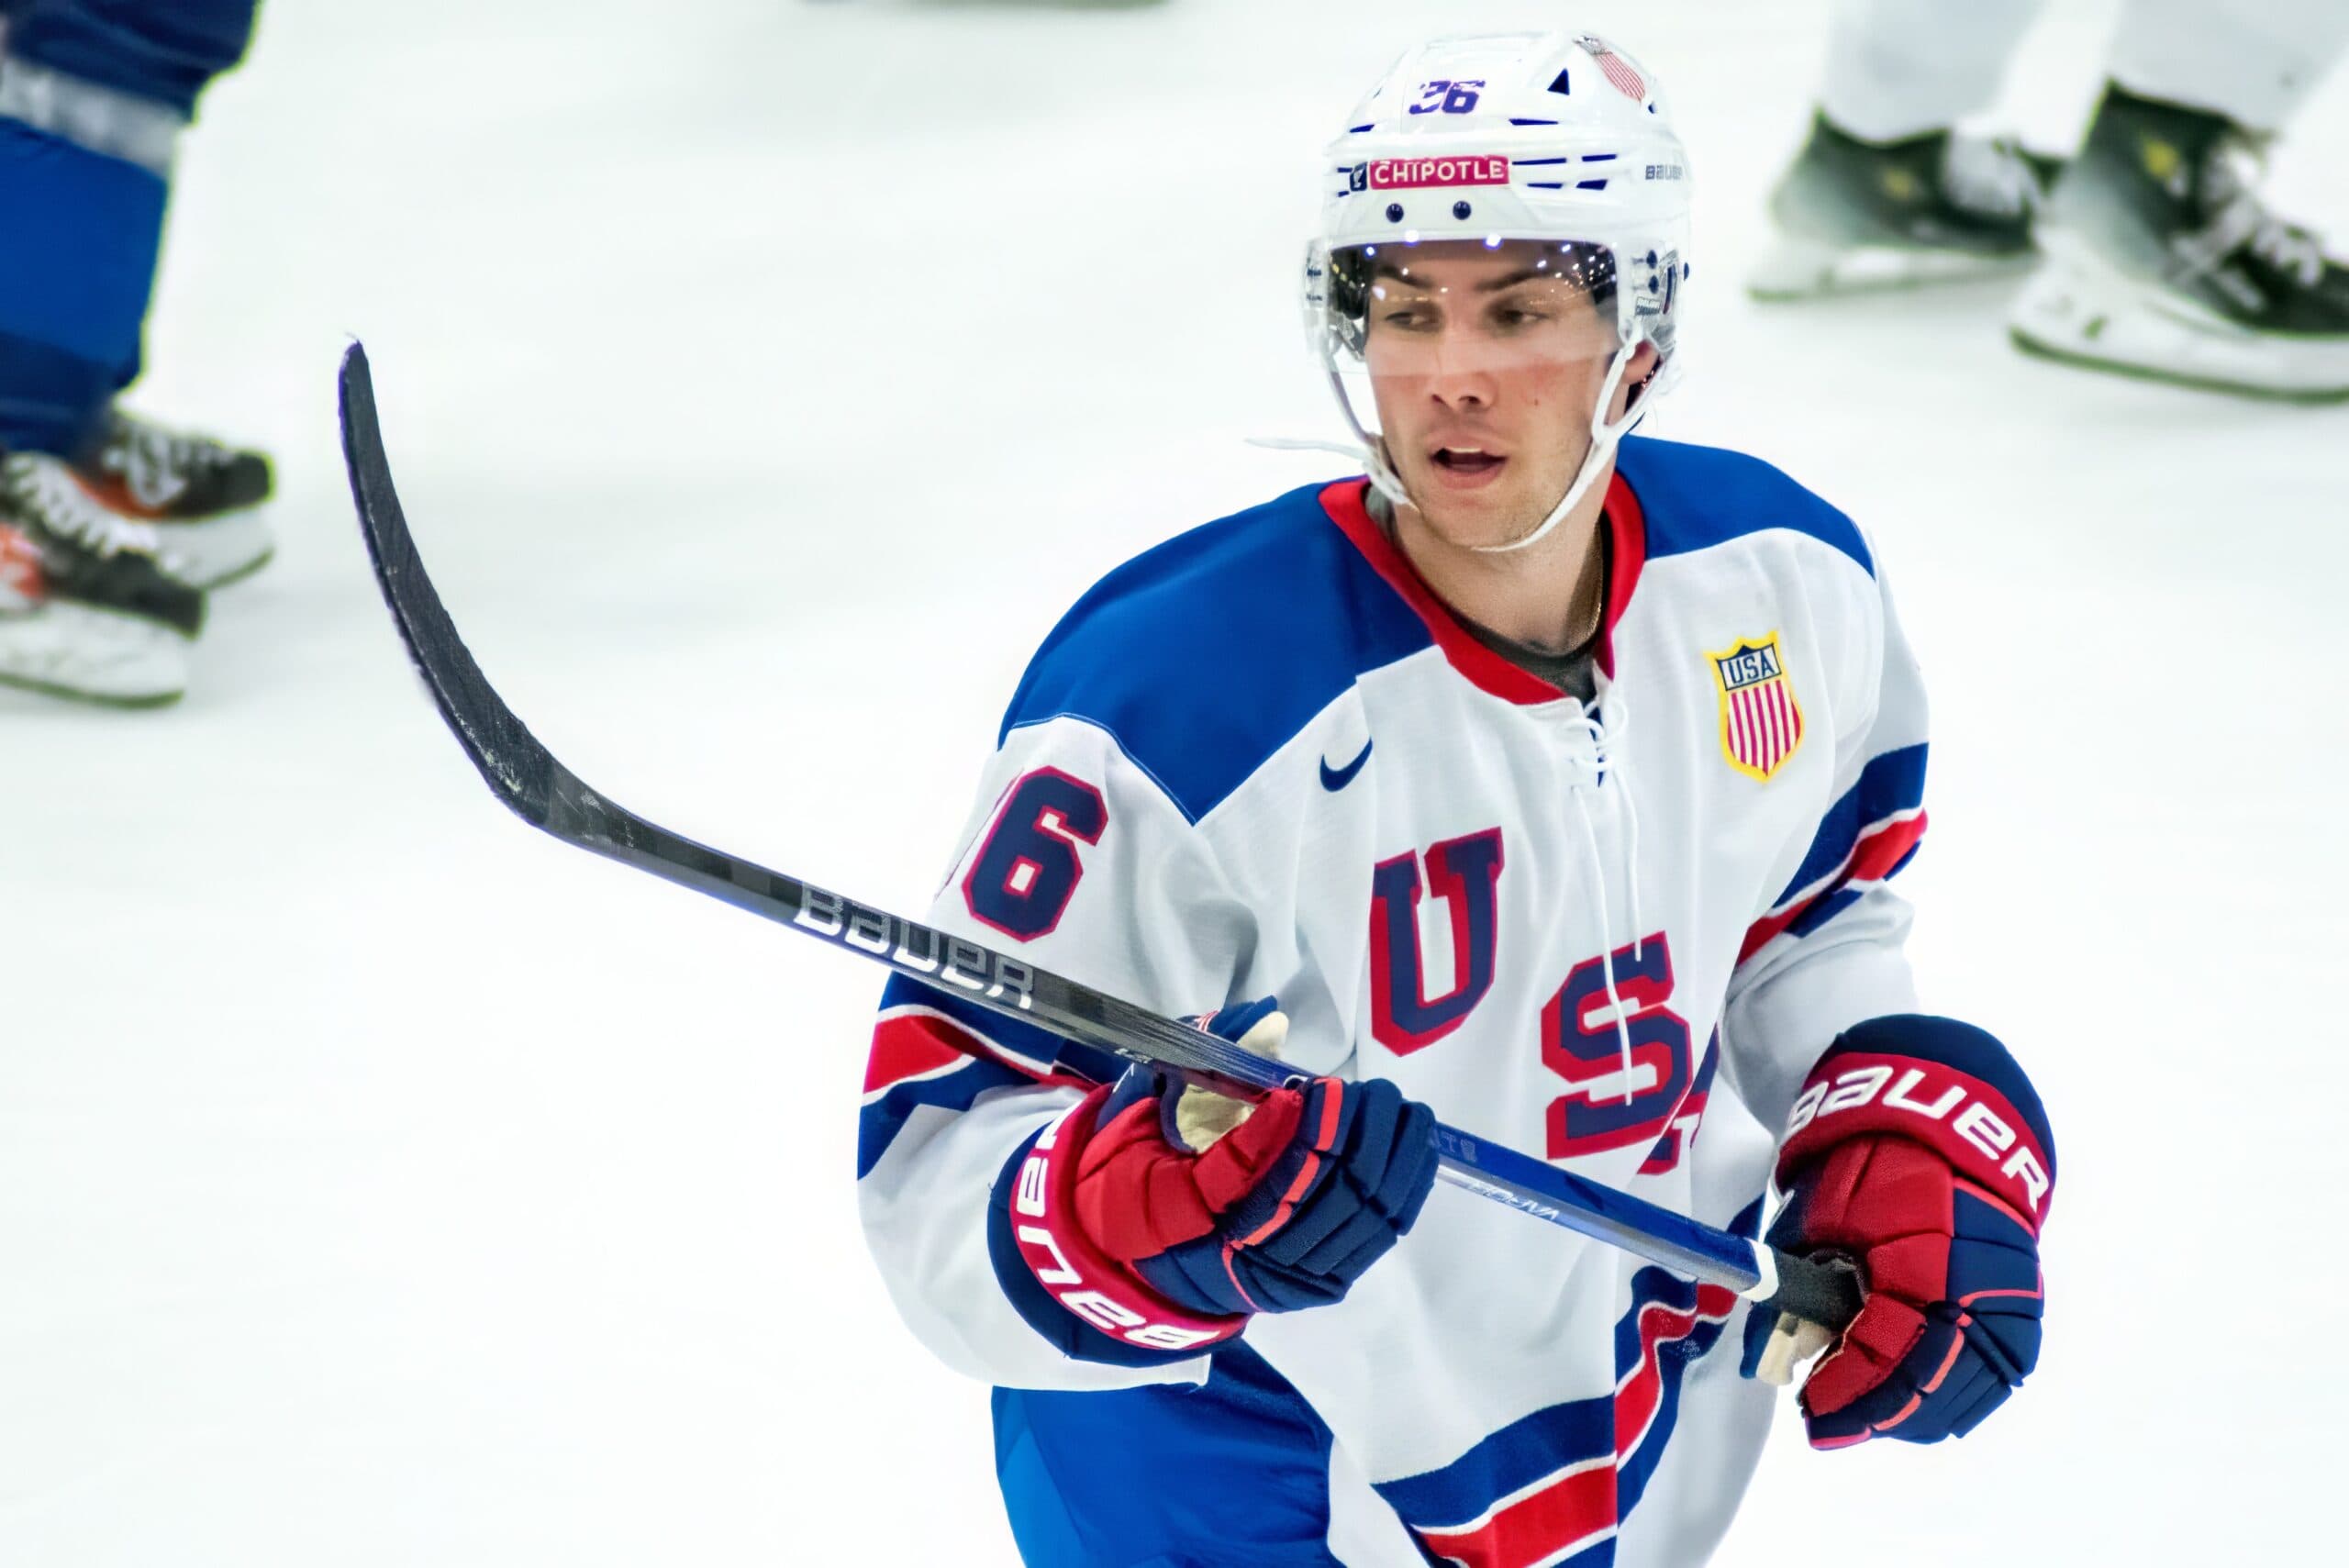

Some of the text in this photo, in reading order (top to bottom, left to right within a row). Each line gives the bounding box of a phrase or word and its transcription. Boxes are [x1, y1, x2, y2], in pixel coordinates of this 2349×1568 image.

[1408, 80, 1486, 115] 36
[1375, 160, 1505, 183] CHIPOTLE
[1728, 649, 1776, 684] USA
